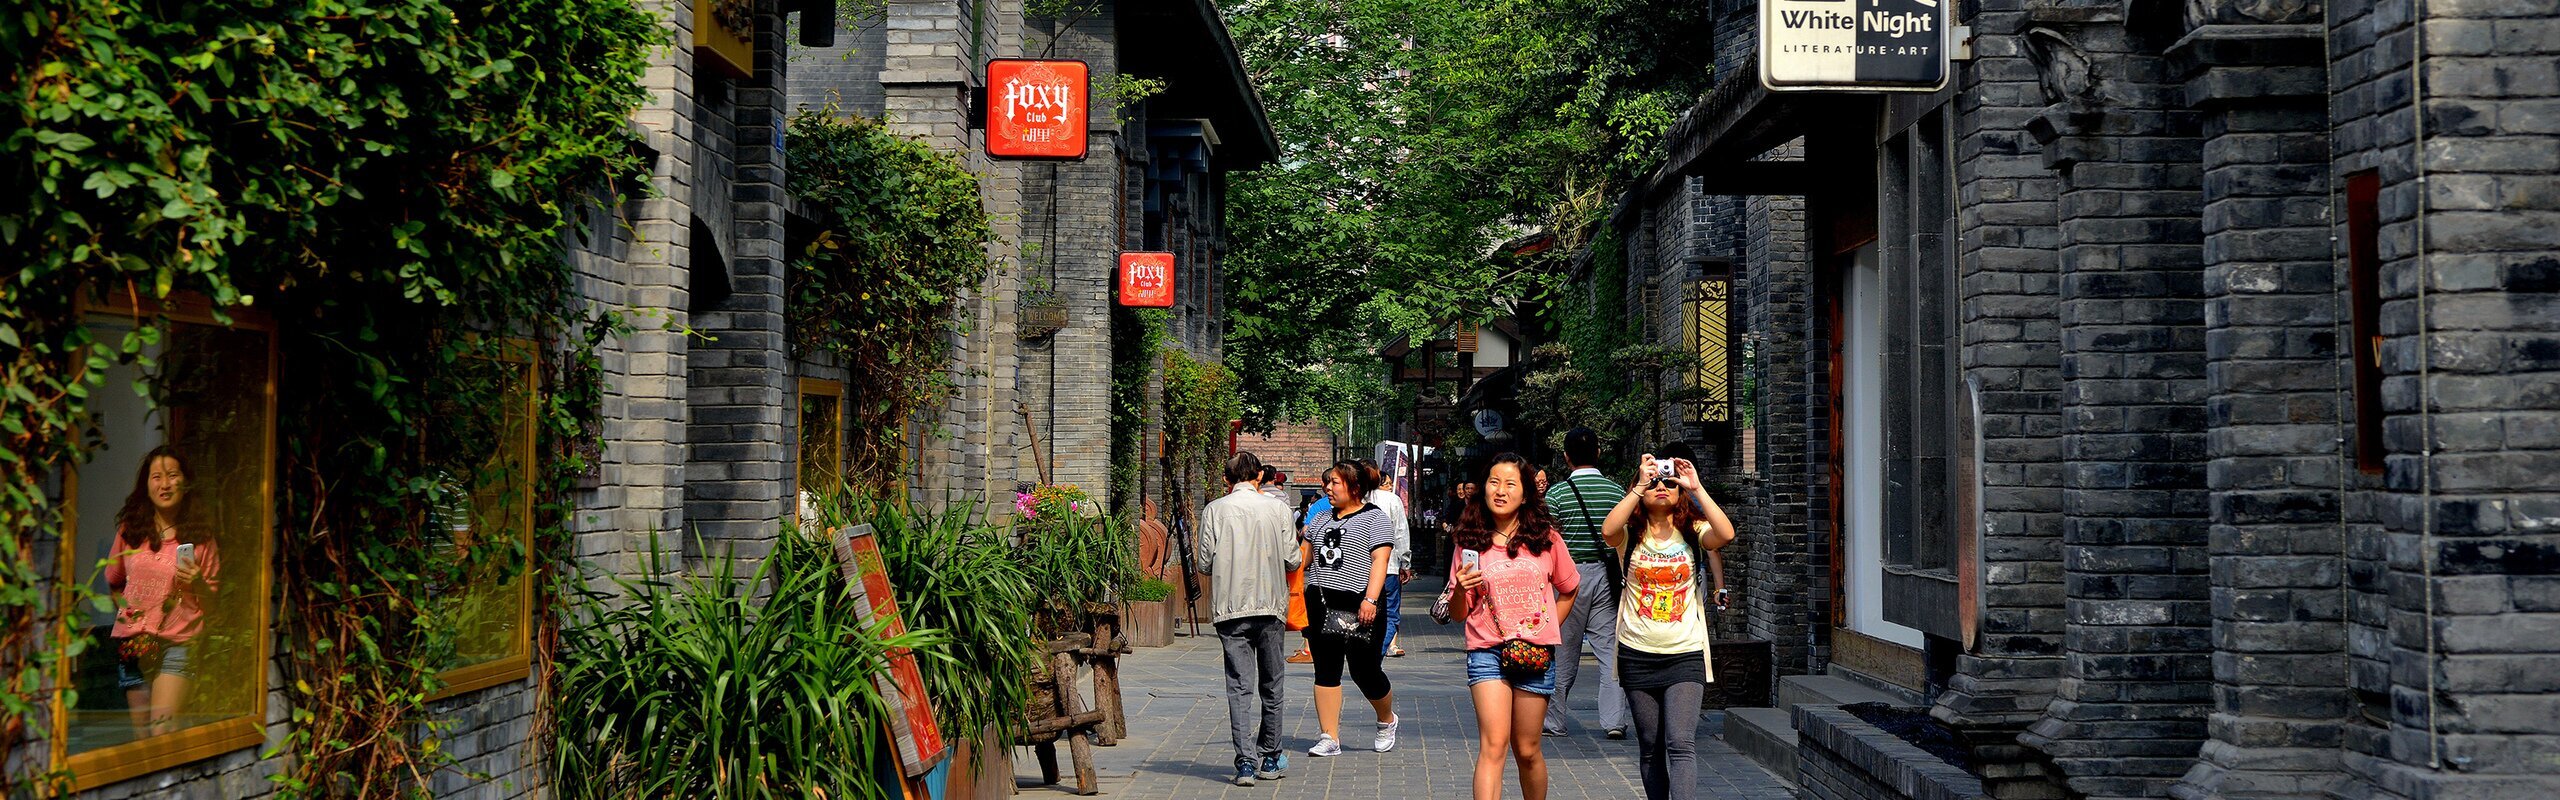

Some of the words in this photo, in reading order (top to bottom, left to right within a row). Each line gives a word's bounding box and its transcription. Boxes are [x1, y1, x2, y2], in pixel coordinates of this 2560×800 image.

[1781, 9, 1854, 30] White
[1862, 10, 1932, 38] Night
[1004, 77, 1069, 125] foxy
[1026, 112, 1047, 123] Club
[1129, 261, 1165, 288] foxy
[1028, 310, 1067, 321] WELCOME
